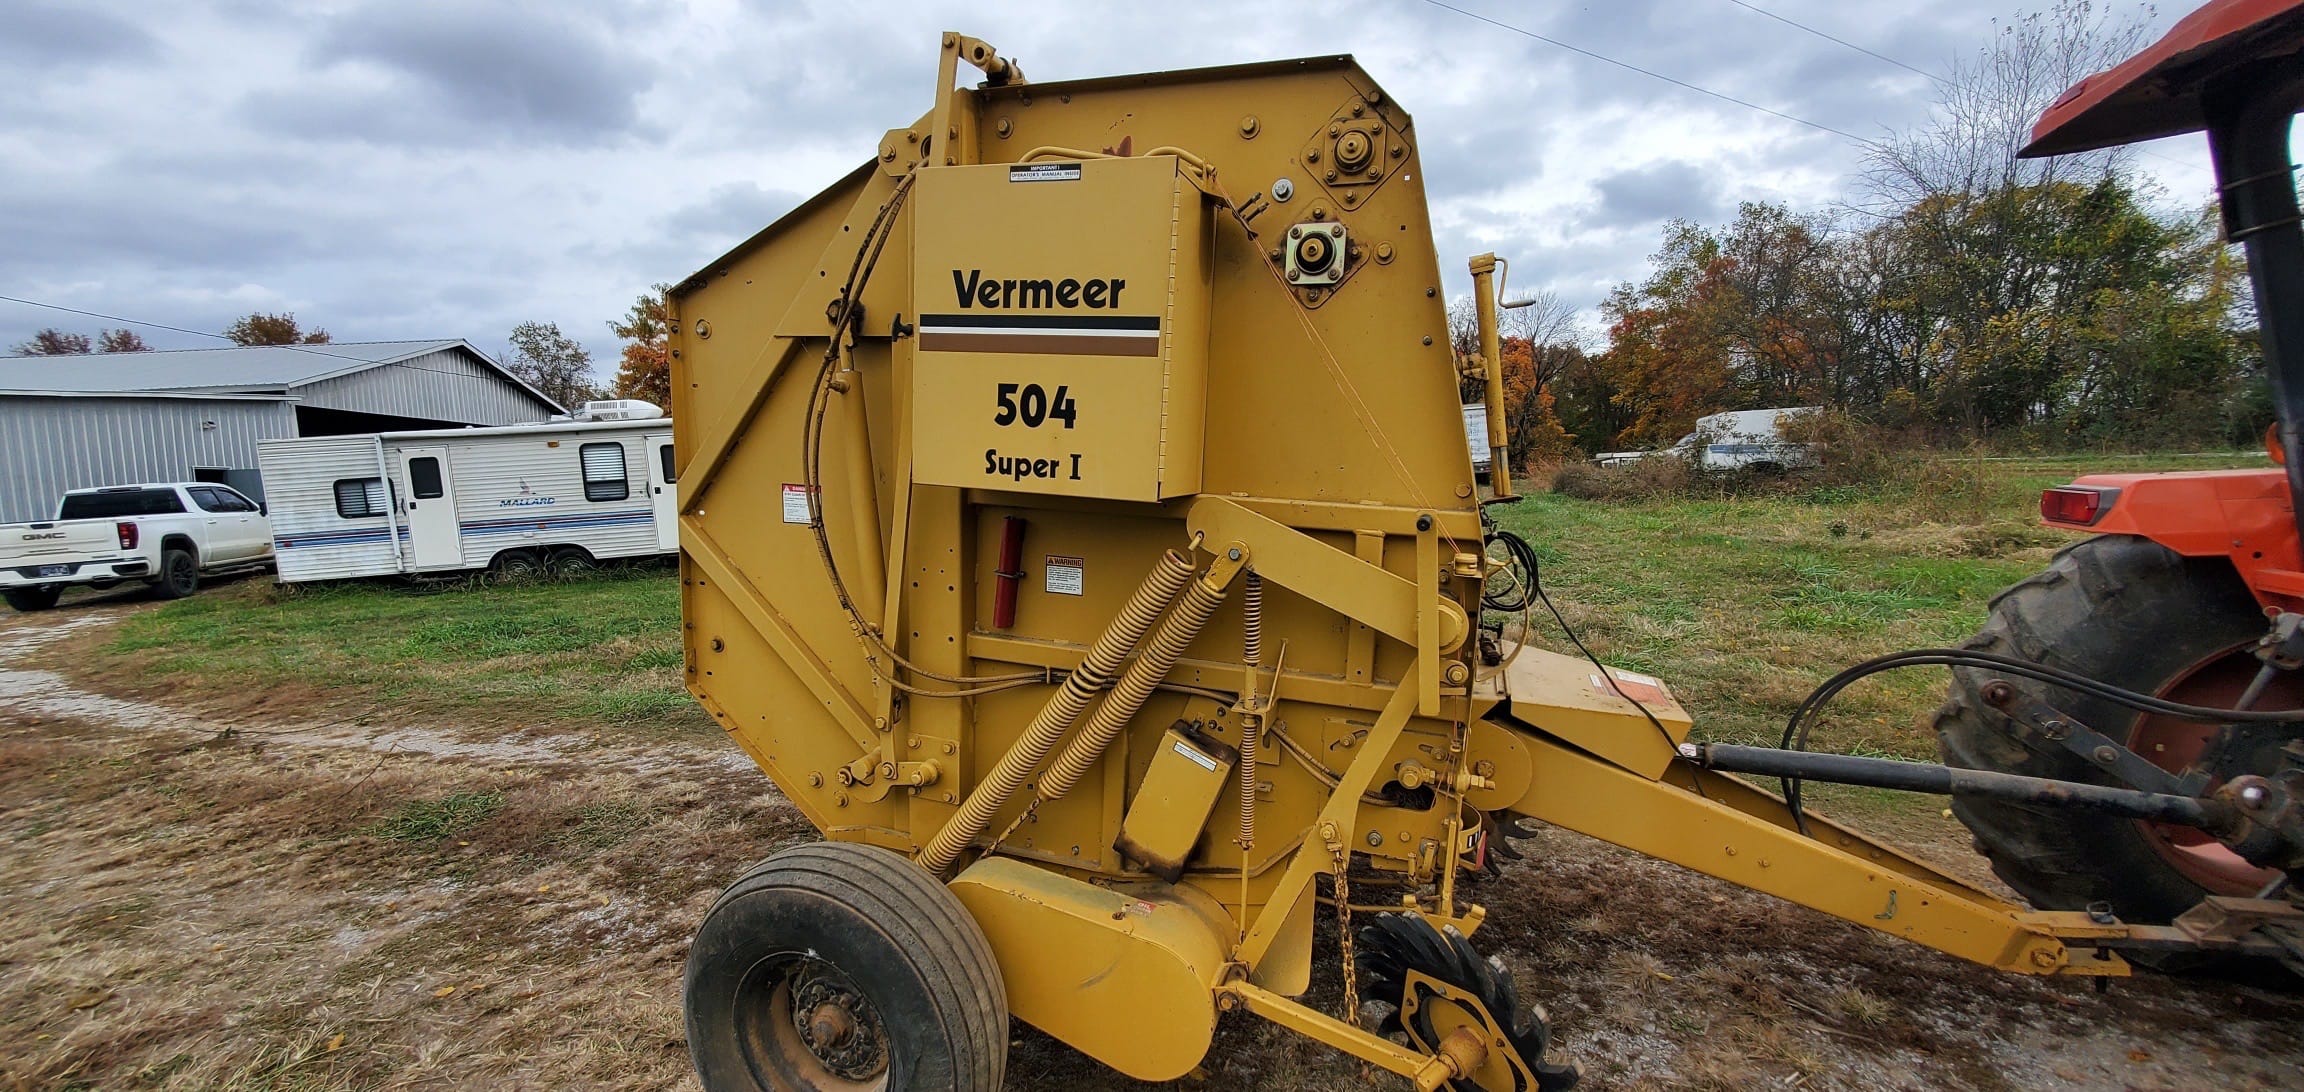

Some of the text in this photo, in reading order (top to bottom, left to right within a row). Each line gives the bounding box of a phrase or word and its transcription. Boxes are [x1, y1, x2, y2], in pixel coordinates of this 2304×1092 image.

[952, 269, 1126, 309] Vermeer
[994, 382, 1077, 429] 504
[985, 448, 1082, 482] Super I
[500, 497, 556, 507] MALLARD
[22, 532, 66, 540] GMC
[1054, 557, 1082, 567] WARNING
